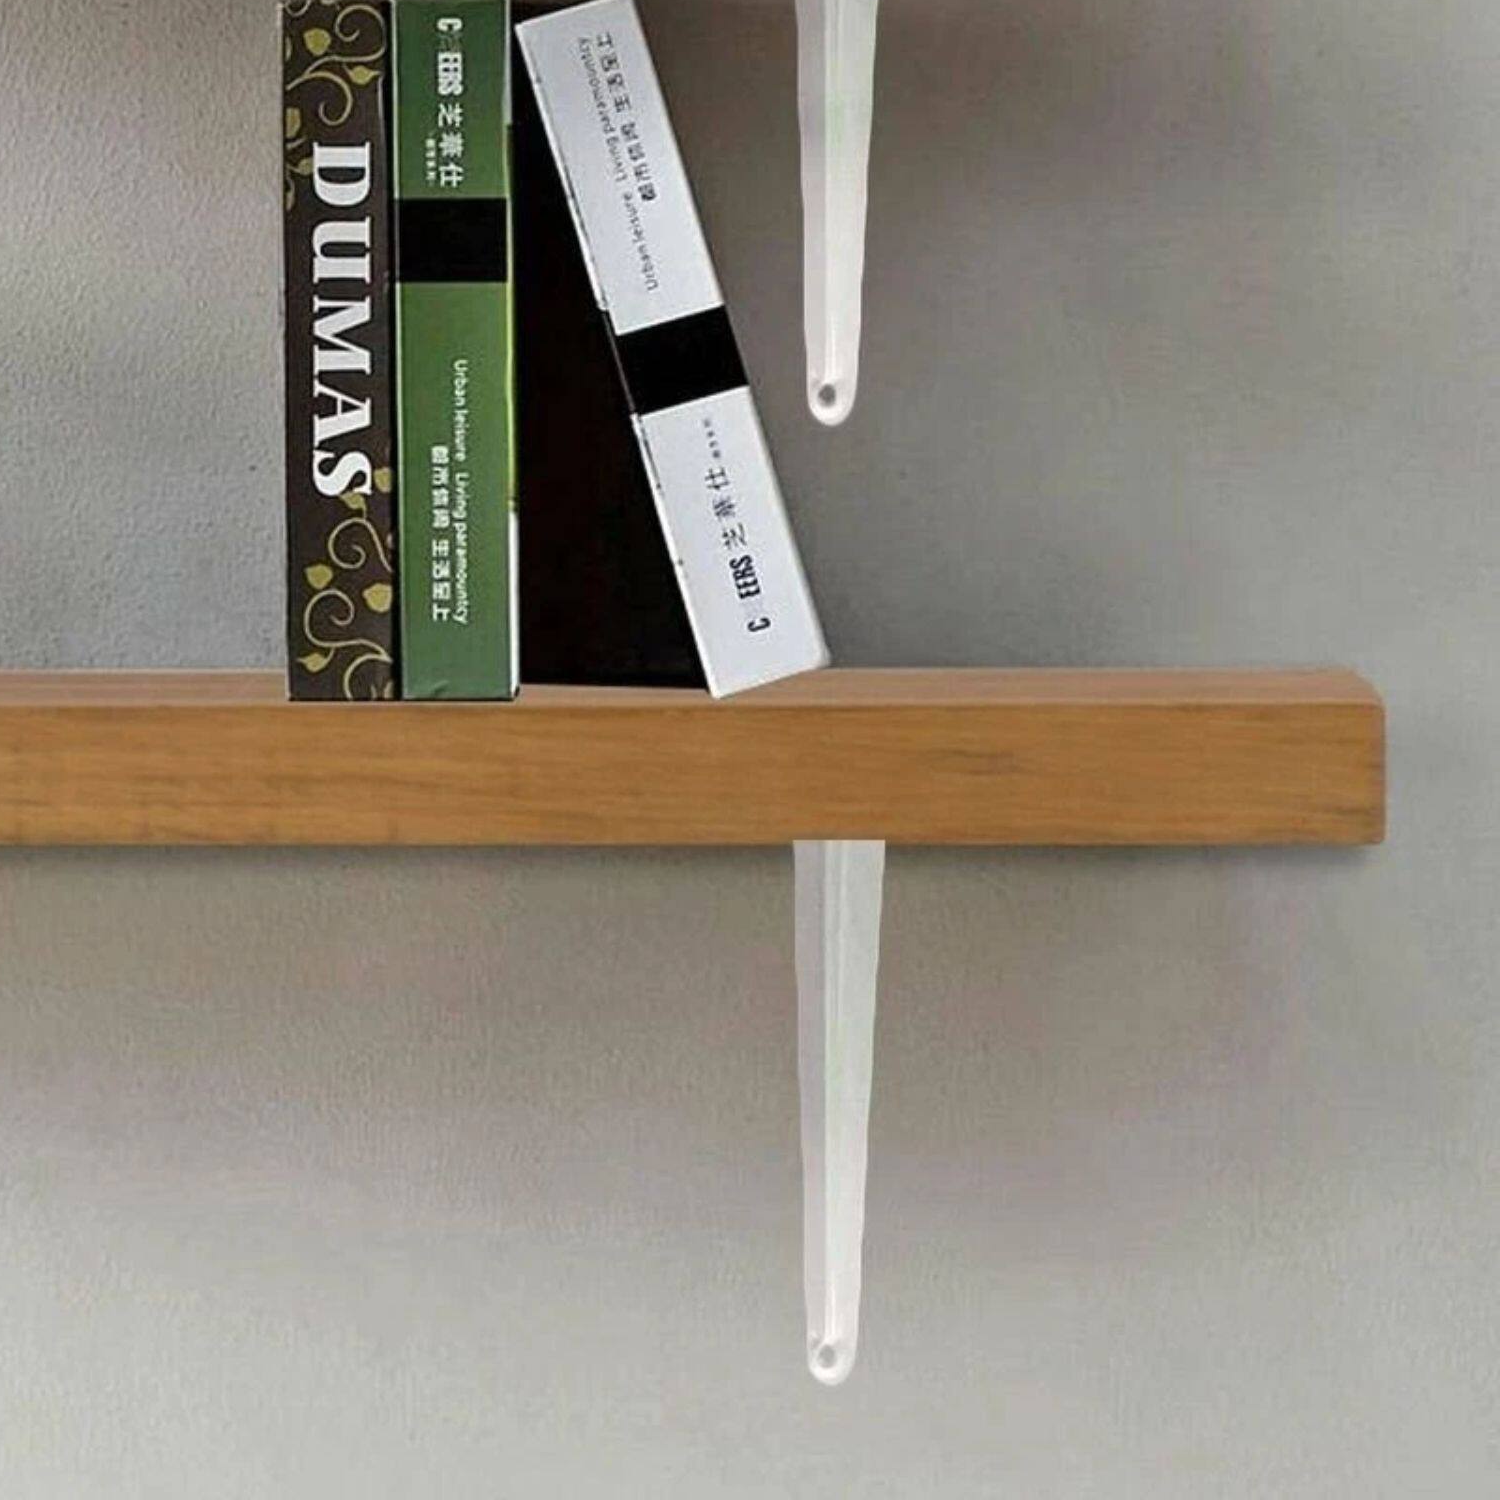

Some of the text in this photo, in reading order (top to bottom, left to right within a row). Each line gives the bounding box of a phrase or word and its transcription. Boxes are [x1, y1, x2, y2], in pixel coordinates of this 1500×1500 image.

[312, 141, 373, 497] DUMAS
[453, 359, 469, 407] Urban
[454, 409, 469, 462] leisure
[452, 471, 470, 519] Living
